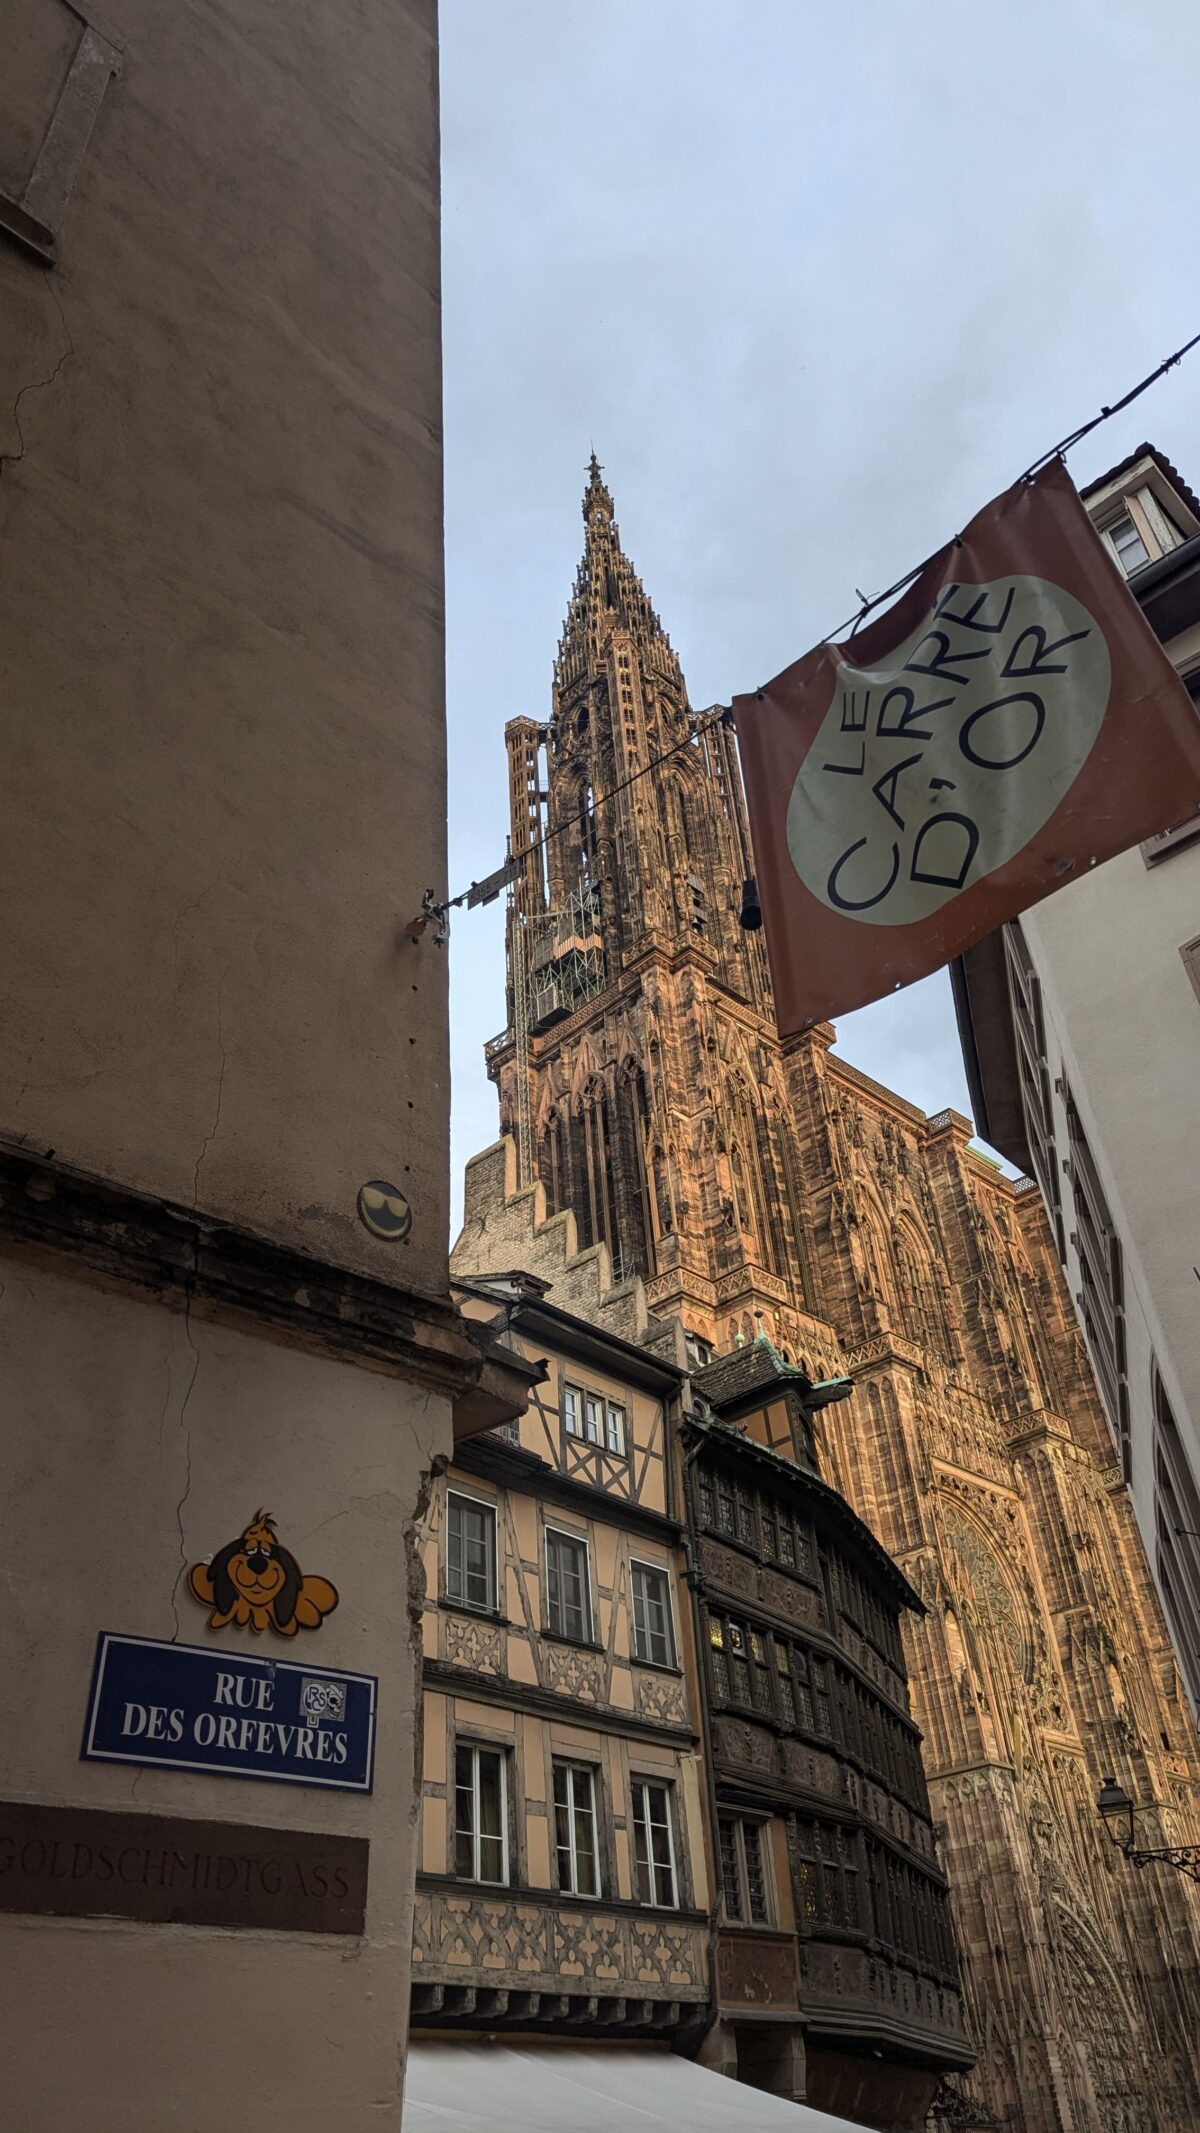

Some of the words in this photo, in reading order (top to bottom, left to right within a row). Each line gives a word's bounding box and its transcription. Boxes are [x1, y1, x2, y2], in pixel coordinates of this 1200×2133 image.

[822, 690, 871, 776] LE
[910, 625, 1092, 889] D'OR
[213, 1672, 275, 1711] RUE
[120, 1702, 185, 1742] DES
[193, 1713, 348, 1764] ORFEVRES
[0, 1837, 349, 1898] GOLDSCHMIDTGASS
